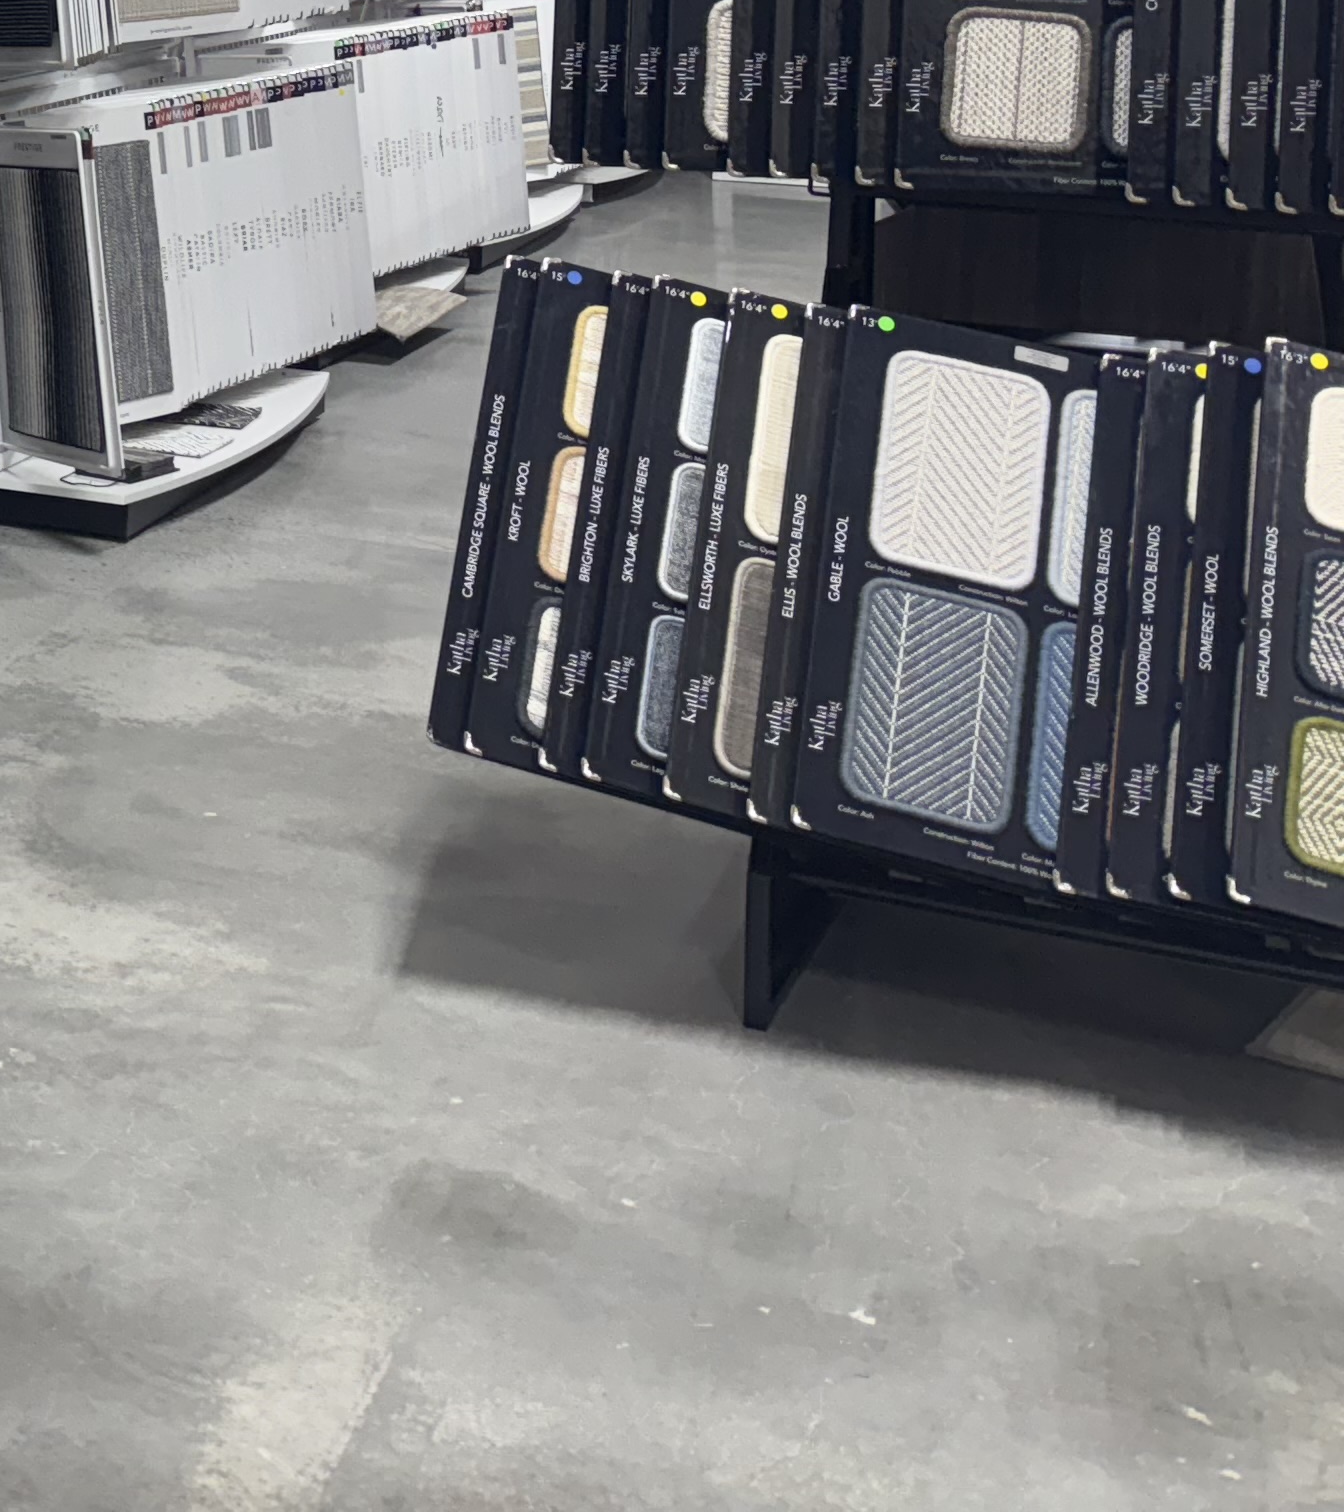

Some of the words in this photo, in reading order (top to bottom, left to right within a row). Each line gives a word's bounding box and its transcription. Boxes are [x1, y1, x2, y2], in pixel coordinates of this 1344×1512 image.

[488, 394, 506, 439] BLENDS
[482, 439, 499, 476] WOOL
[594, 446, 610, 483] FIBERS
[634, 455, 651, 495] FIBERS
[515, 460, 531, 497] WOOL
[588, 481, 604, 515] LUXE
[713, 463, 729, 501] FIBERS
[473, 482, 491, 529] SQUARE
[507, 503, 524, 542] KROFT
[629, 492, 645, 526] LUXE
[709, 498, 724, 533] LUXE
[791, 493, 808, 541] BLENDS
[578, 522, 598, 583] BRIGHTON
[833, 516, 850, 554] WOOL
[1096, 527, 1113, 575] BLENDS
[1145, 524, 1161, 573] BLENDS
[1263, 526, 1279, 577] BLENDS
[462, 522, 483, 598] CAMBRIDGE
[621, 532, 640, 583] SKYLARK
[698, 539, 719, 611] ELLSWORTH
[786, 541, 802, 580] WOOL
[1204, 553, 1219, 594] WOOL
[827, 562, 844, 602] GABLE
[1093, 577, 1108, 616] WOOL
[1142, 575, 1157, 615] WOOL
[1260, 578, 1276, 619] WOOL
[781, 588, 796, 619] ELLIS
[1198, 602, 1216, 671] SOMERSET
[1085, 625, 1105, 707] ALLENWOOD
[1135, 623, 1154, 706] WOODRIDGE
[1256, 629, 1272, 698] HIGHLAND
